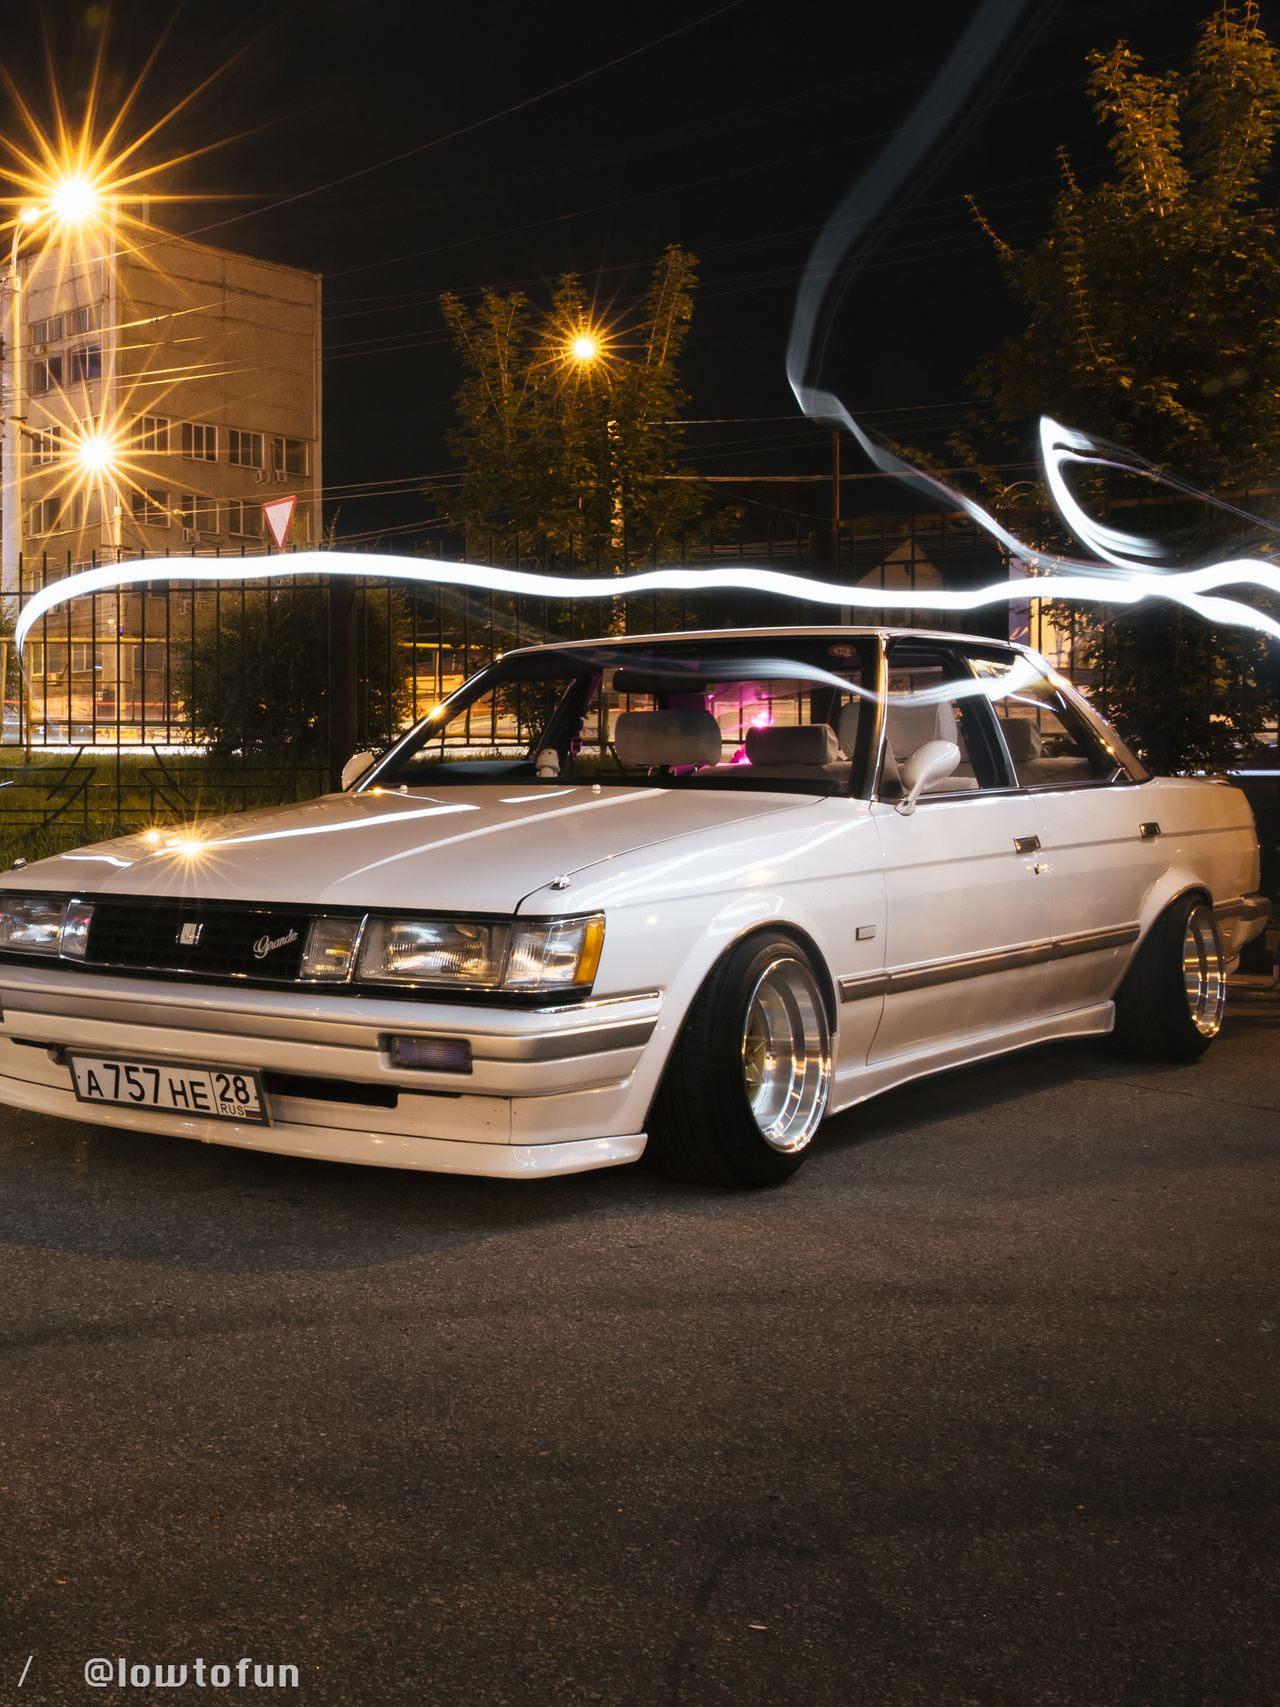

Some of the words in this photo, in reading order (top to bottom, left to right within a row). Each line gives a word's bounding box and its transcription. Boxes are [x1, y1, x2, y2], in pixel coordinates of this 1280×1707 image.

[252, 928, 298, 959] Grande
[215, 1073, 250, 1104] 28
[220, 1103, 245, 1116] RUS
